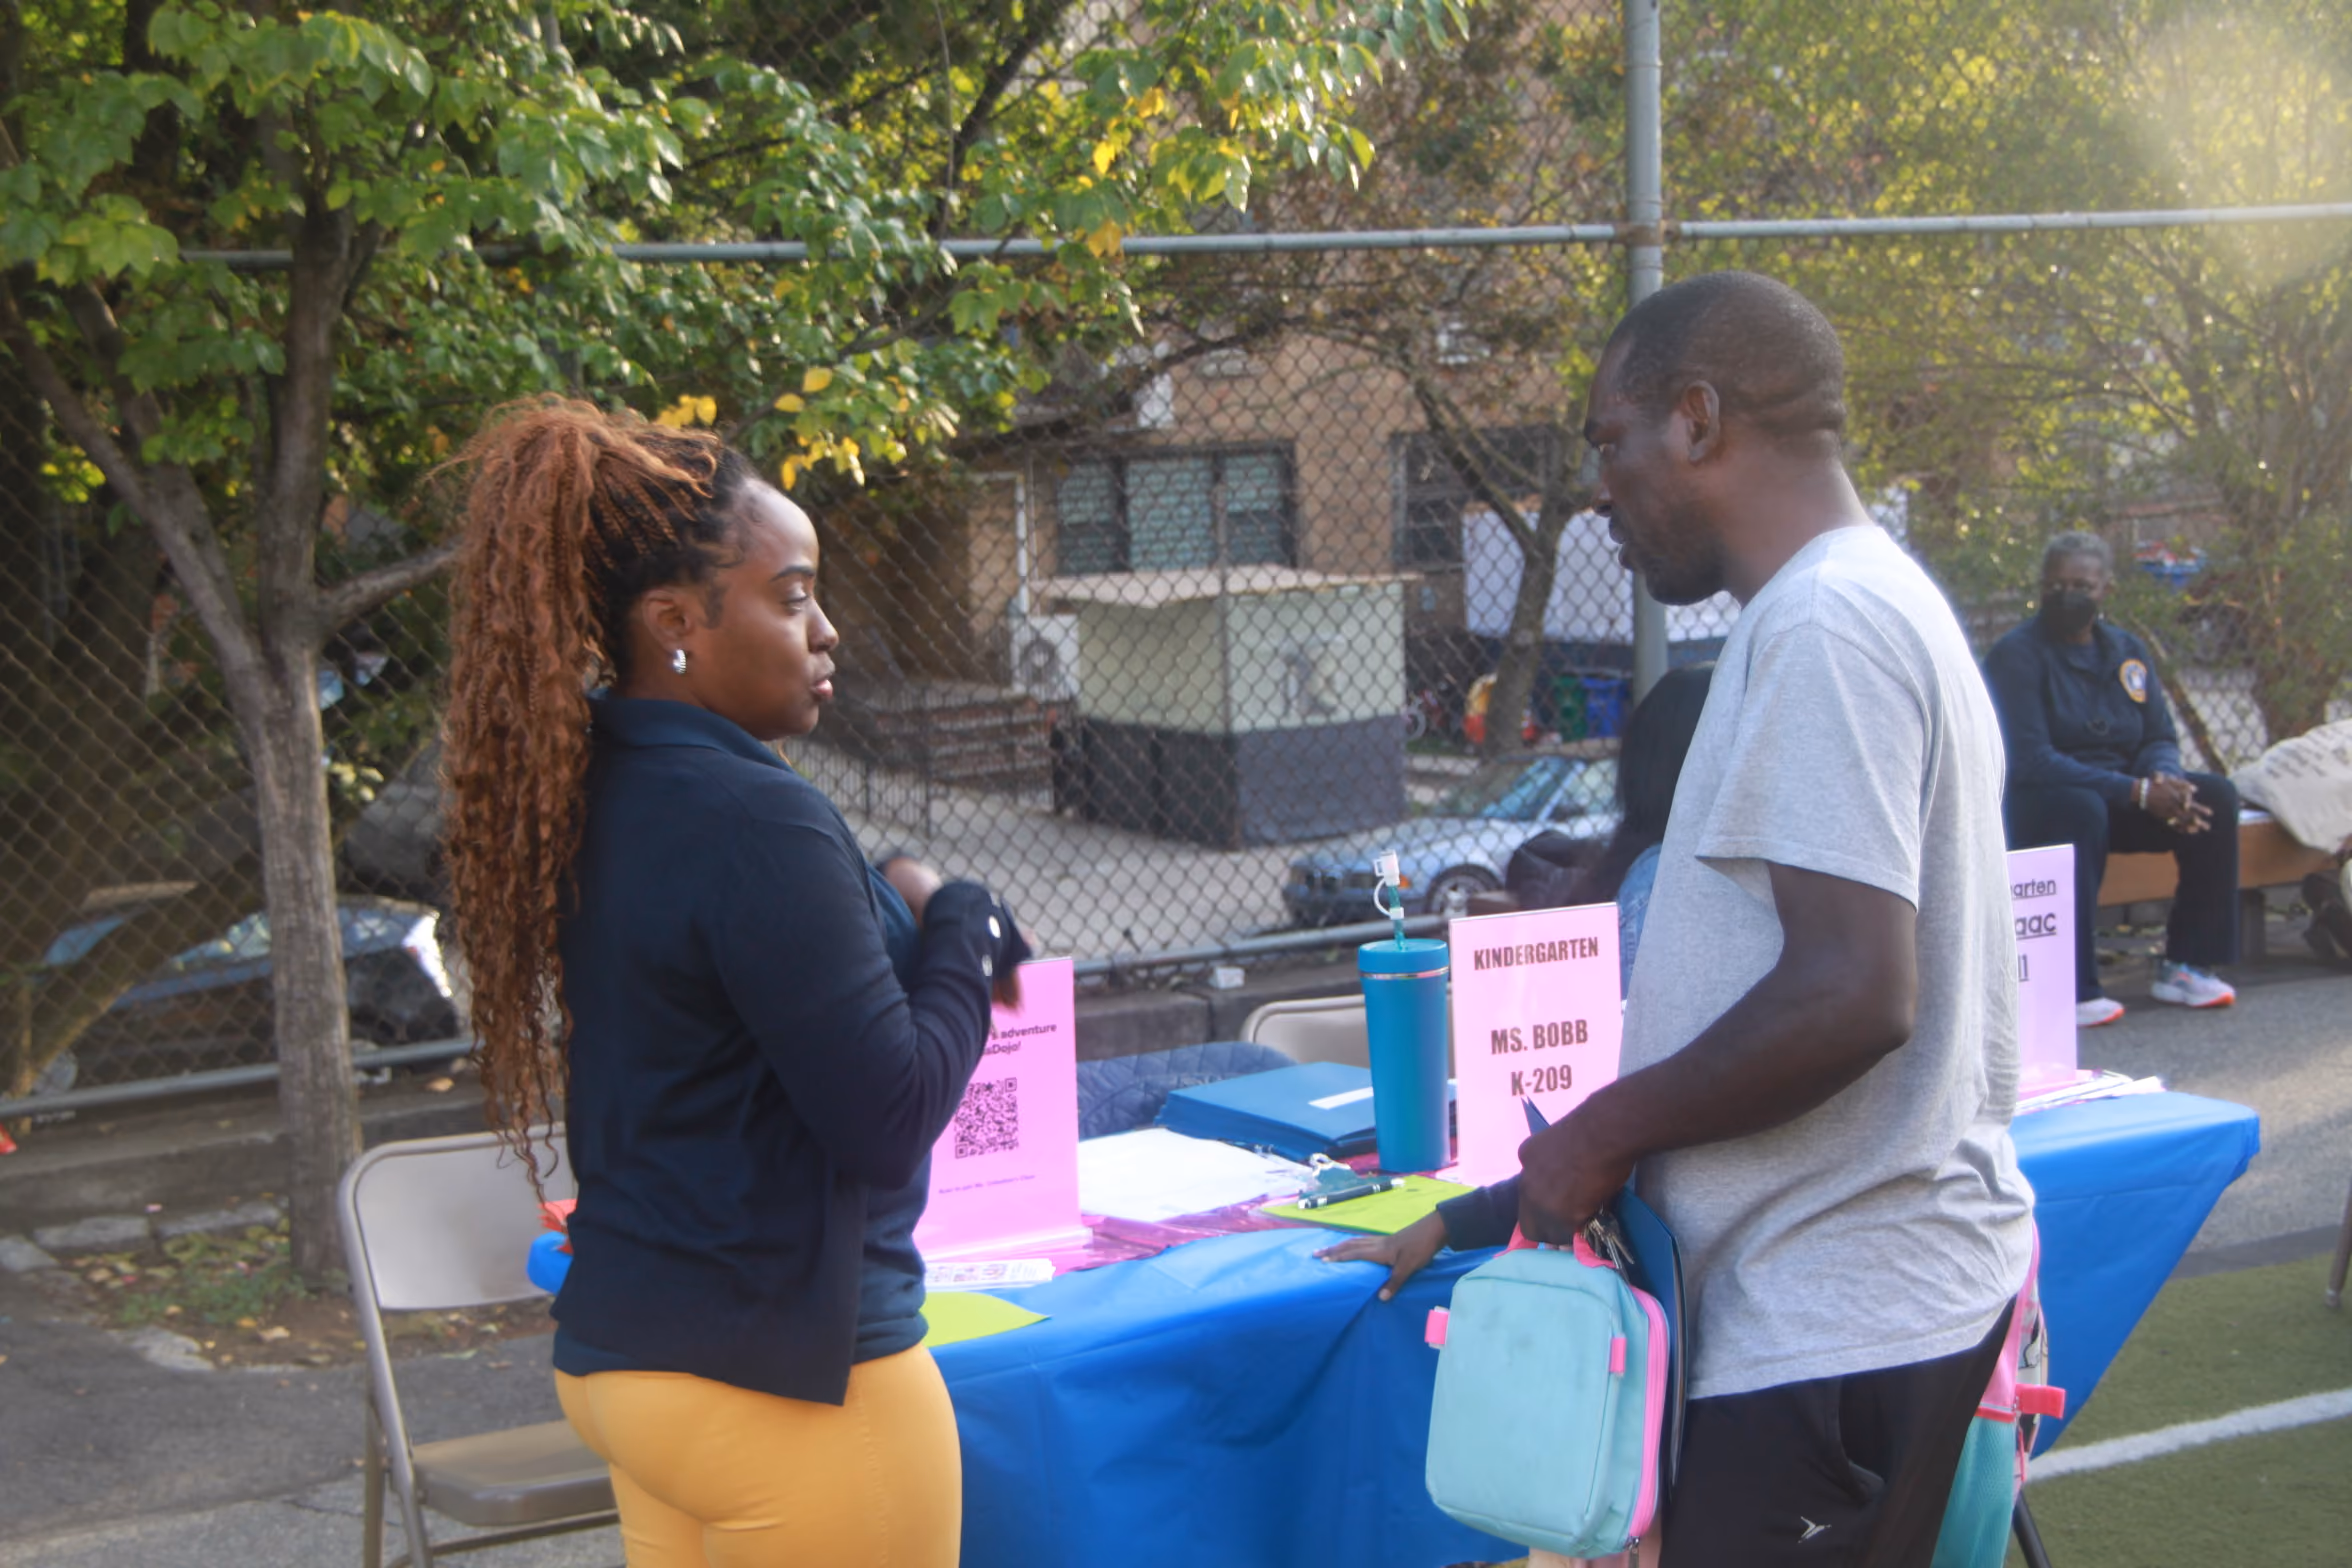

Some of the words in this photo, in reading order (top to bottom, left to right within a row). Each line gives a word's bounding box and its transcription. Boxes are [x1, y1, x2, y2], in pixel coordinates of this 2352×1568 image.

[2010, 879, 2057, 898] arten
[2015, 912, 2057, 937] aac
[1474, 937, 1599, 970] KINDERGARTEN
[1001, 1024, 1057, 1039] adventure
[1491, 1028, 1528, 1054] MS.
[1533, 1019, 1588, 1049] BOBB
[984, 1041, 1021, 1056] sDojo!
[1511, 1065, 1572, 1096] K-209
